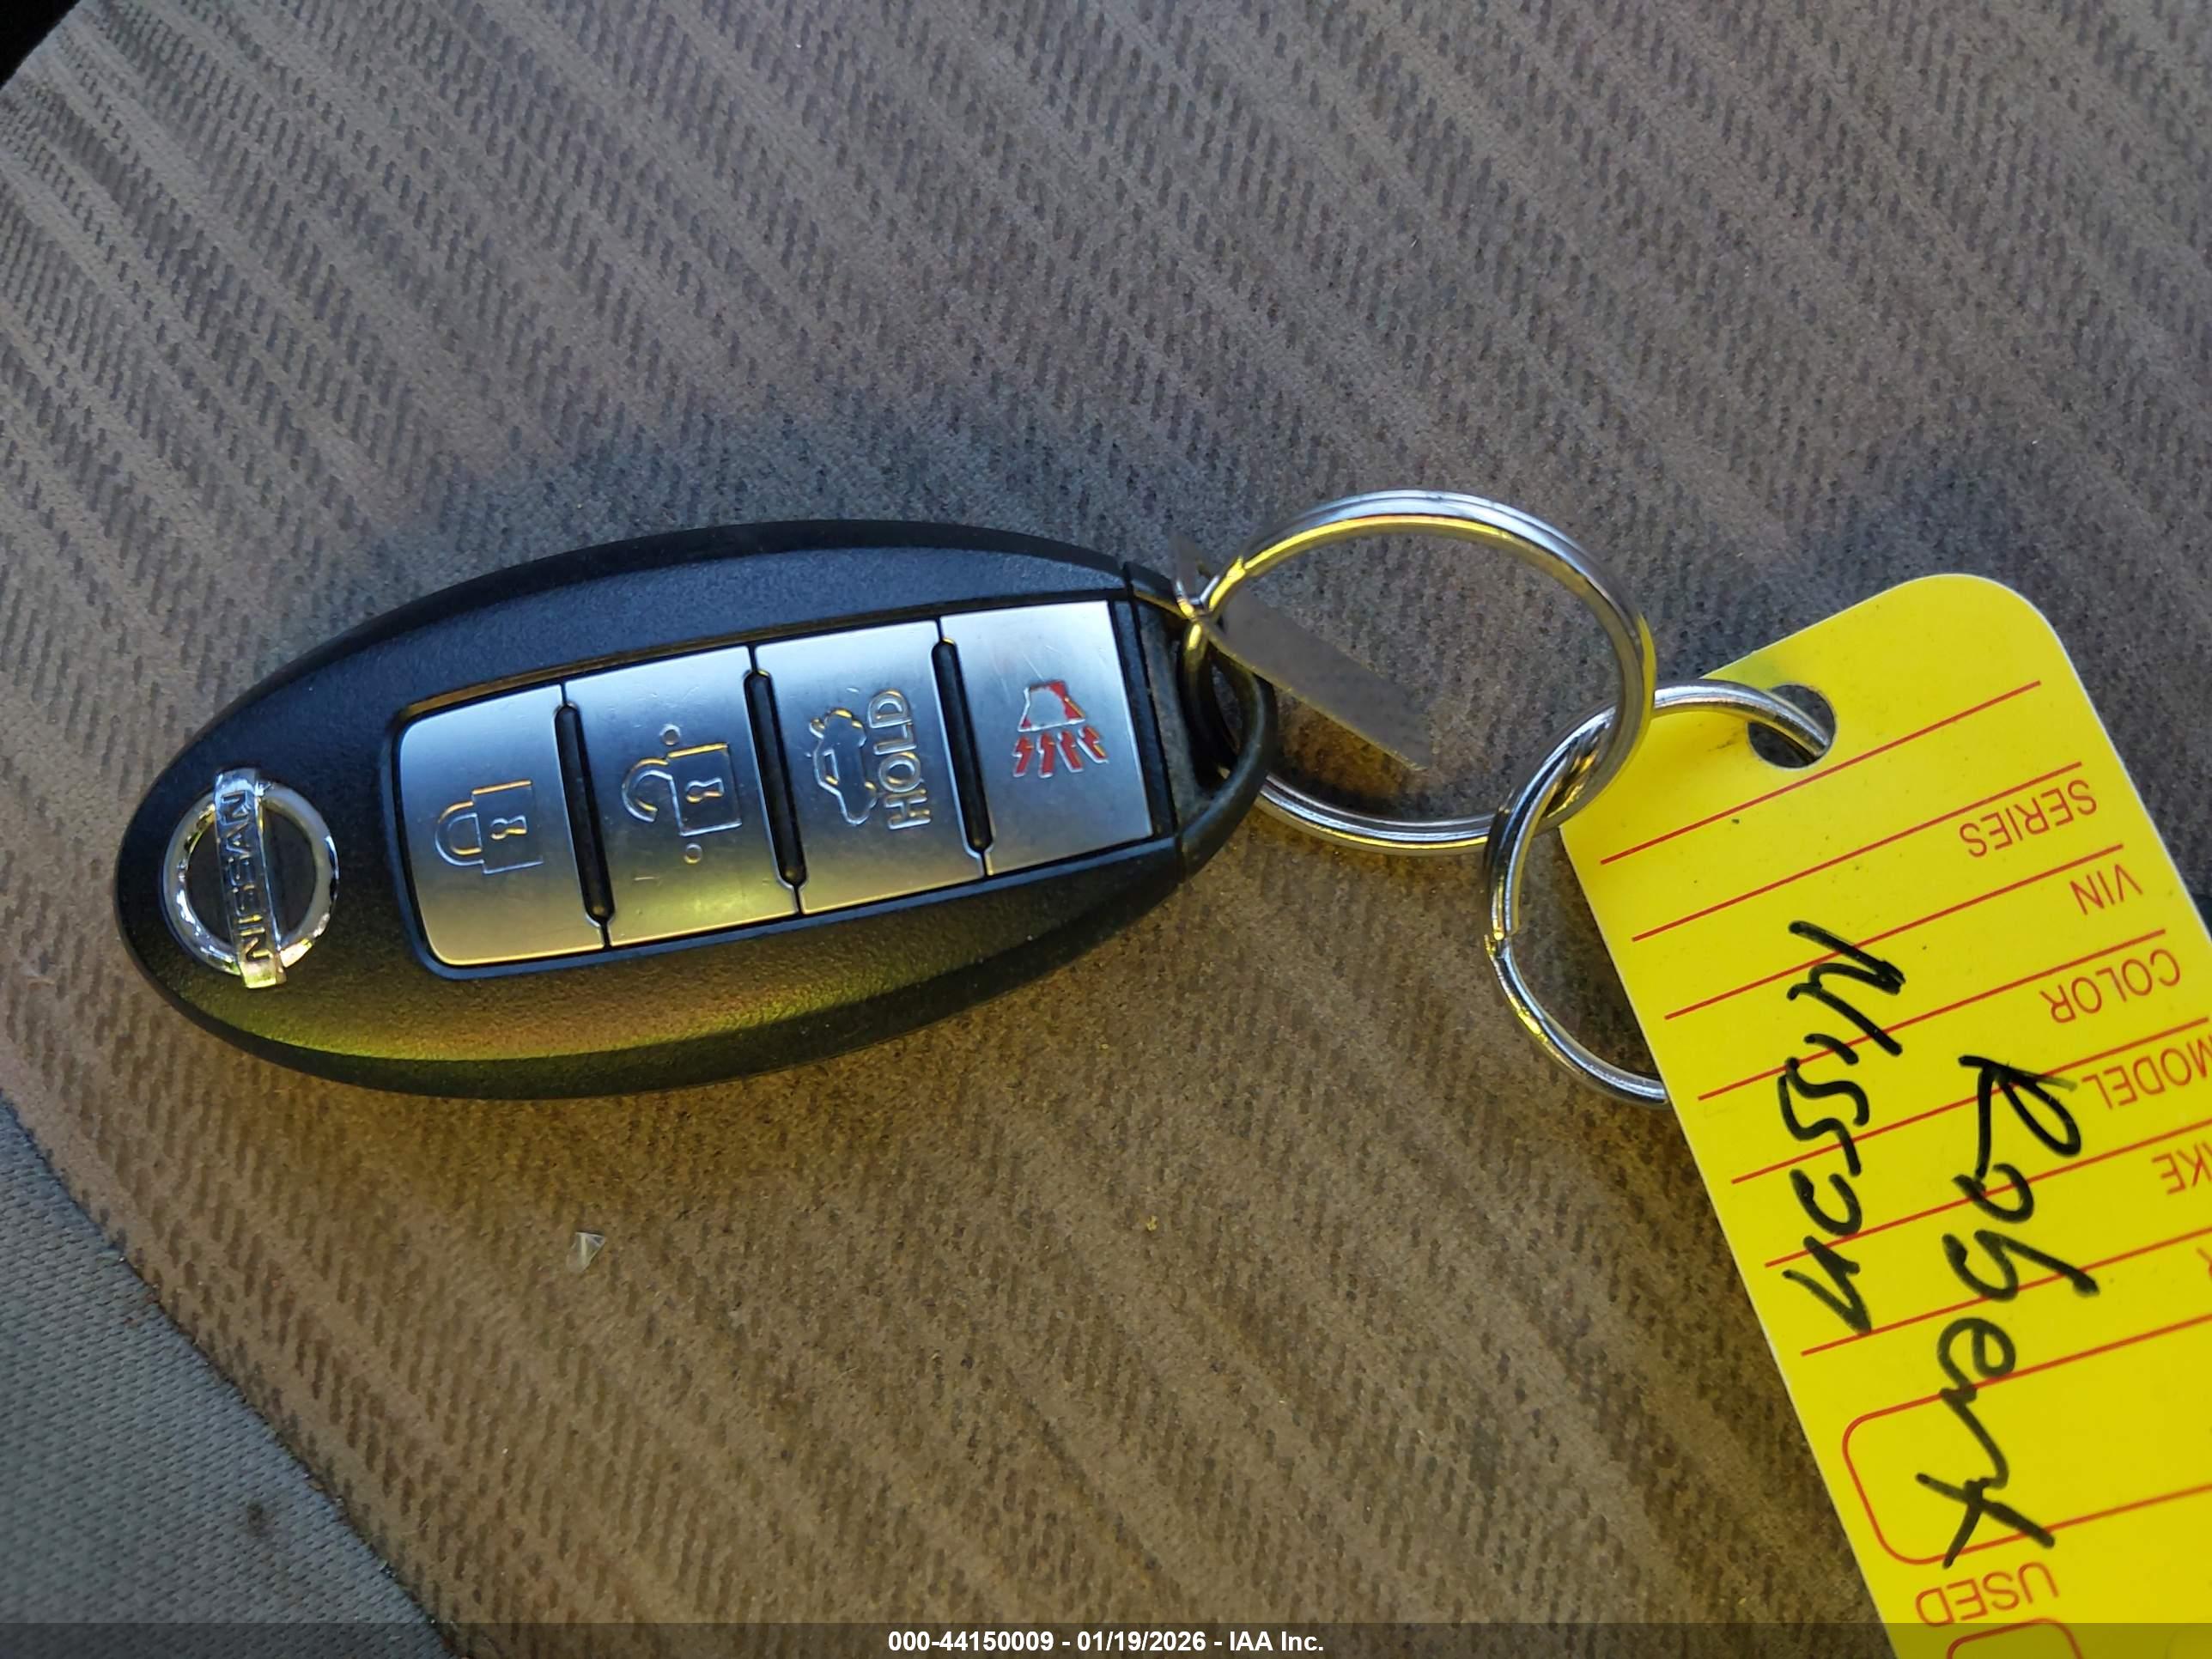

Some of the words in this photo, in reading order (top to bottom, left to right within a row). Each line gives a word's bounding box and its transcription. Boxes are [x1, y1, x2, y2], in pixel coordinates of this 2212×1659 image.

[867, 690, 932, 830] HOLD
[1959, 779, 2097, 858] SERIES
[220, 788, 274, 964] NISSAN
[2069, 863, 2143, 916] VIN
[2039, 948, 2181, 1024] COLOR
[2081, 1034, 2212, 1110] MODEL
[1778, 920, 1906, 1336] Nissan
[1915, 1561, 2060, 1627] USED
